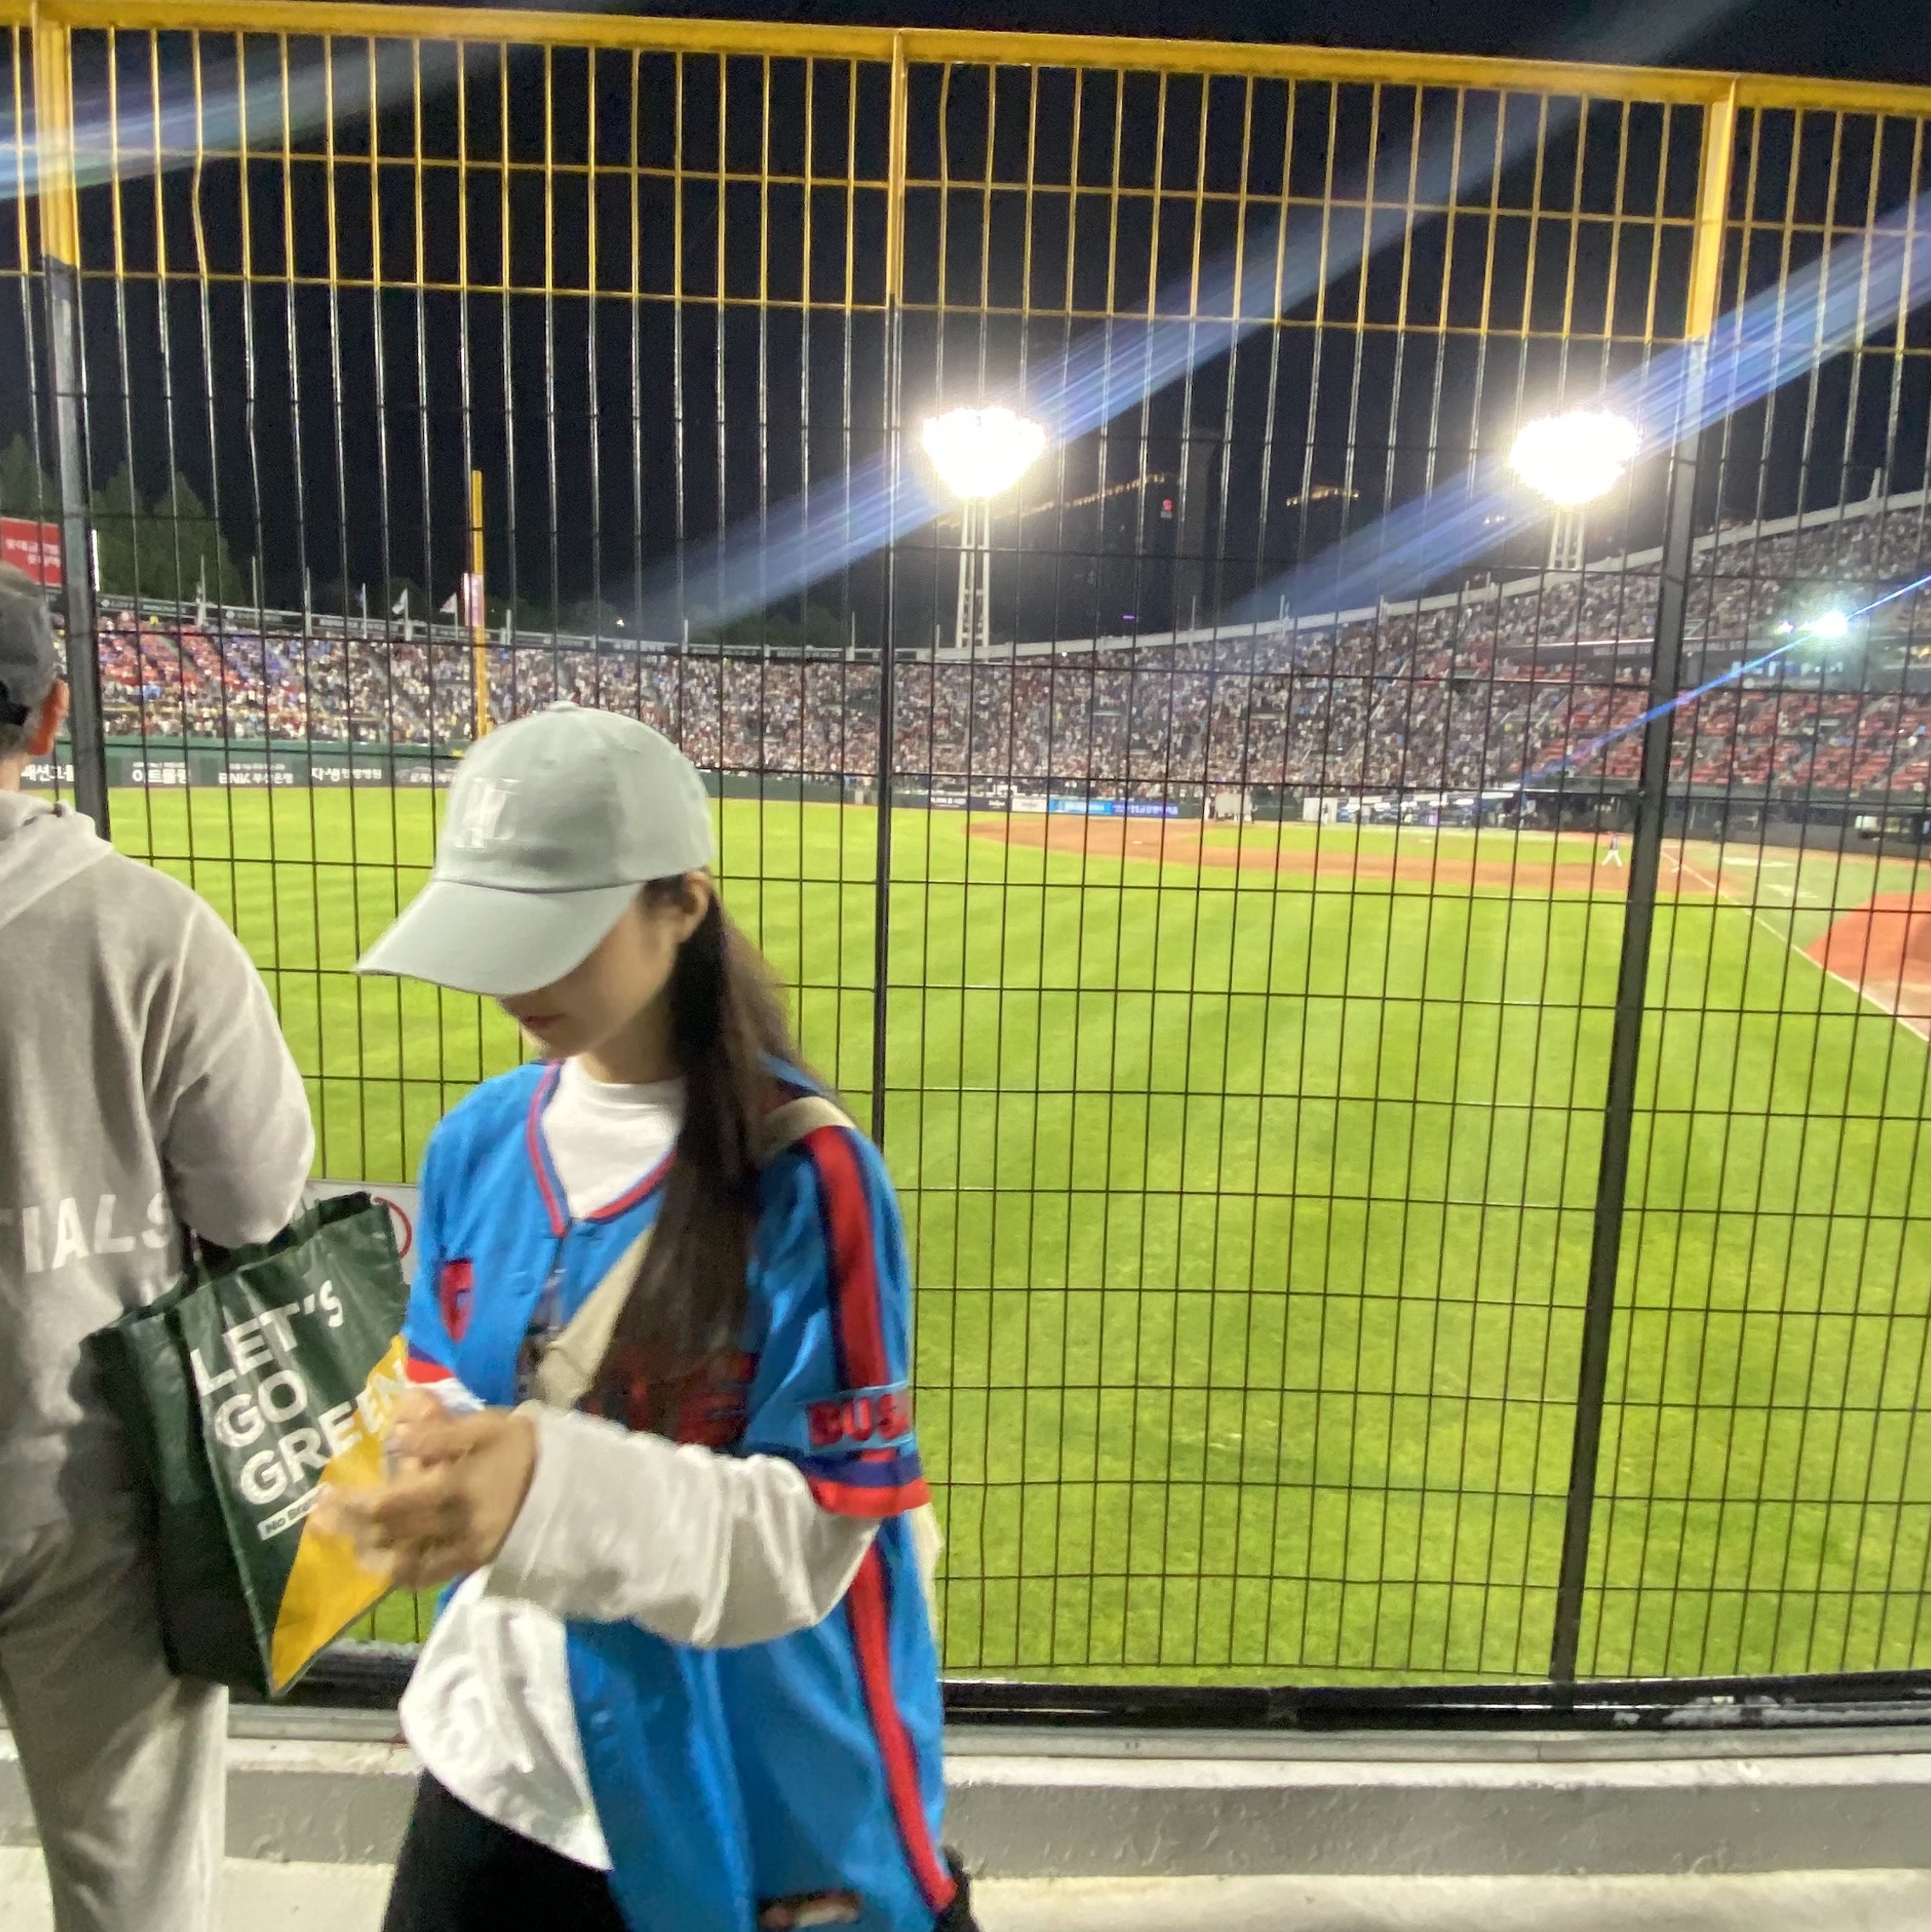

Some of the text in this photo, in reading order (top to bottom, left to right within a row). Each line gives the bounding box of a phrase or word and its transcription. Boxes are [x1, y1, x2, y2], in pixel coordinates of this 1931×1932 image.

[0, 1193, 169, 1273] IALS
[190, 1280, 343, 1396] LET'S
[215, 1369, 307, 1448] GO
